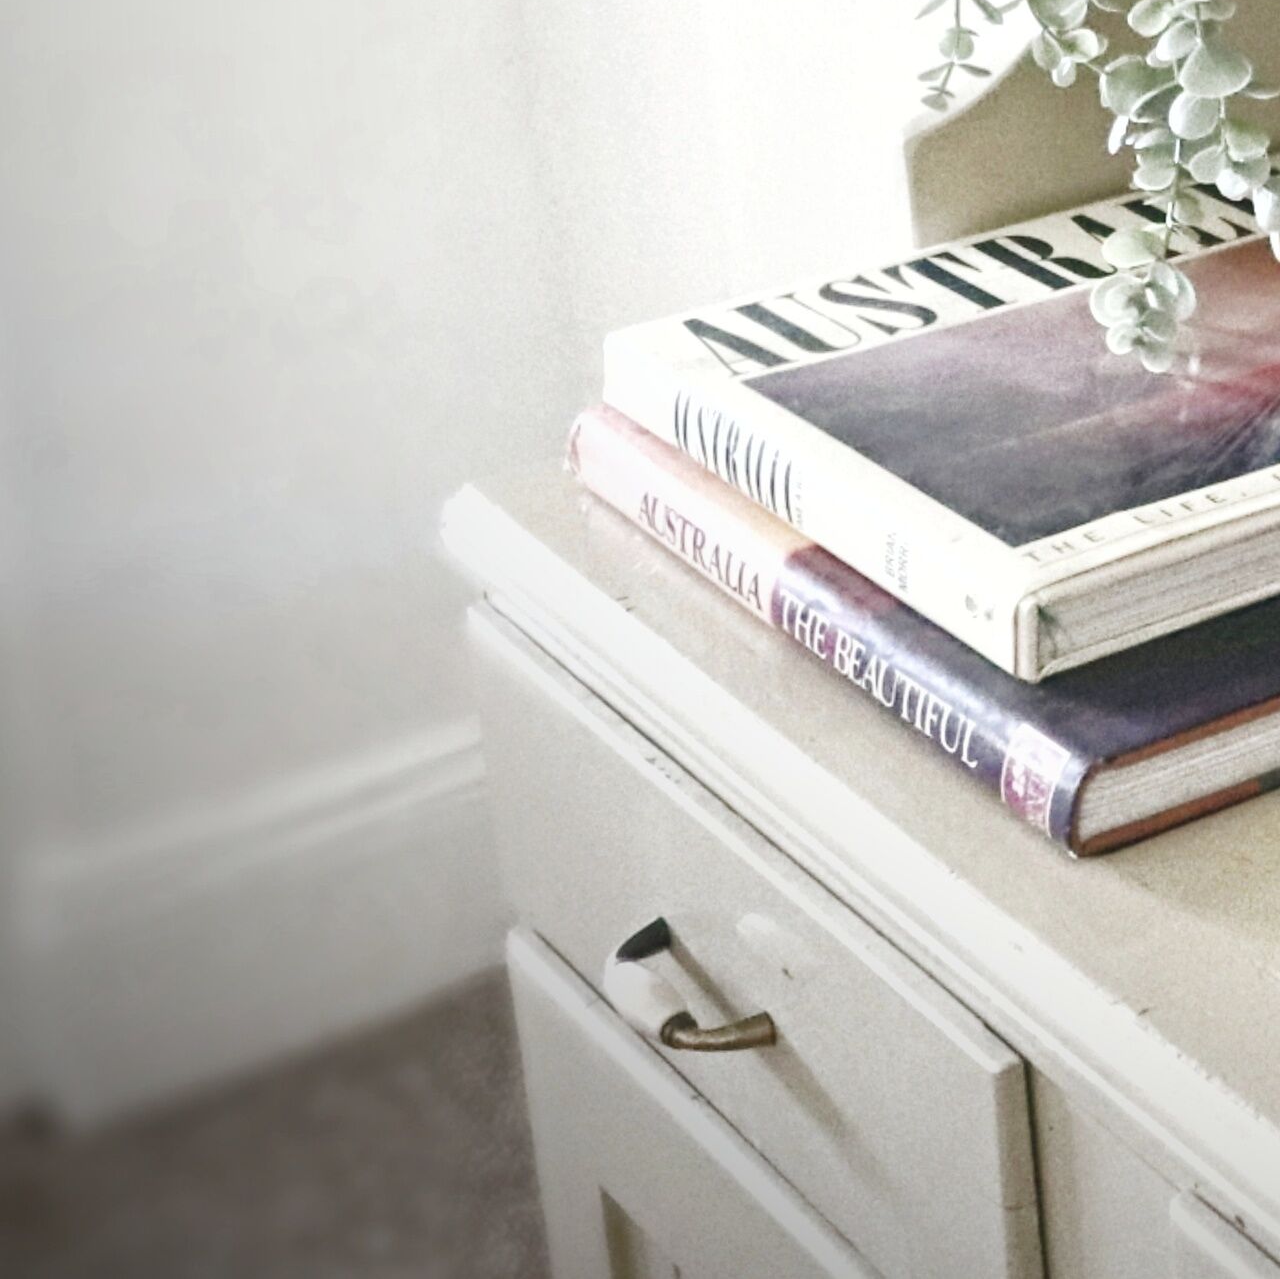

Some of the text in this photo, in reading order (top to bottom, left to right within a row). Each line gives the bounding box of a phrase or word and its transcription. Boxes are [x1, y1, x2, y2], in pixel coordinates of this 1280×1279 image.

[1022, 529, 1099, 563] THE
[1133, 489, 1249, 526] LIFE,
[637, 491, 764, 612] AUSTRALIA
[777, 589, 828, 659] THE
[833, 626, 980, 769] BEAUTIFUL
